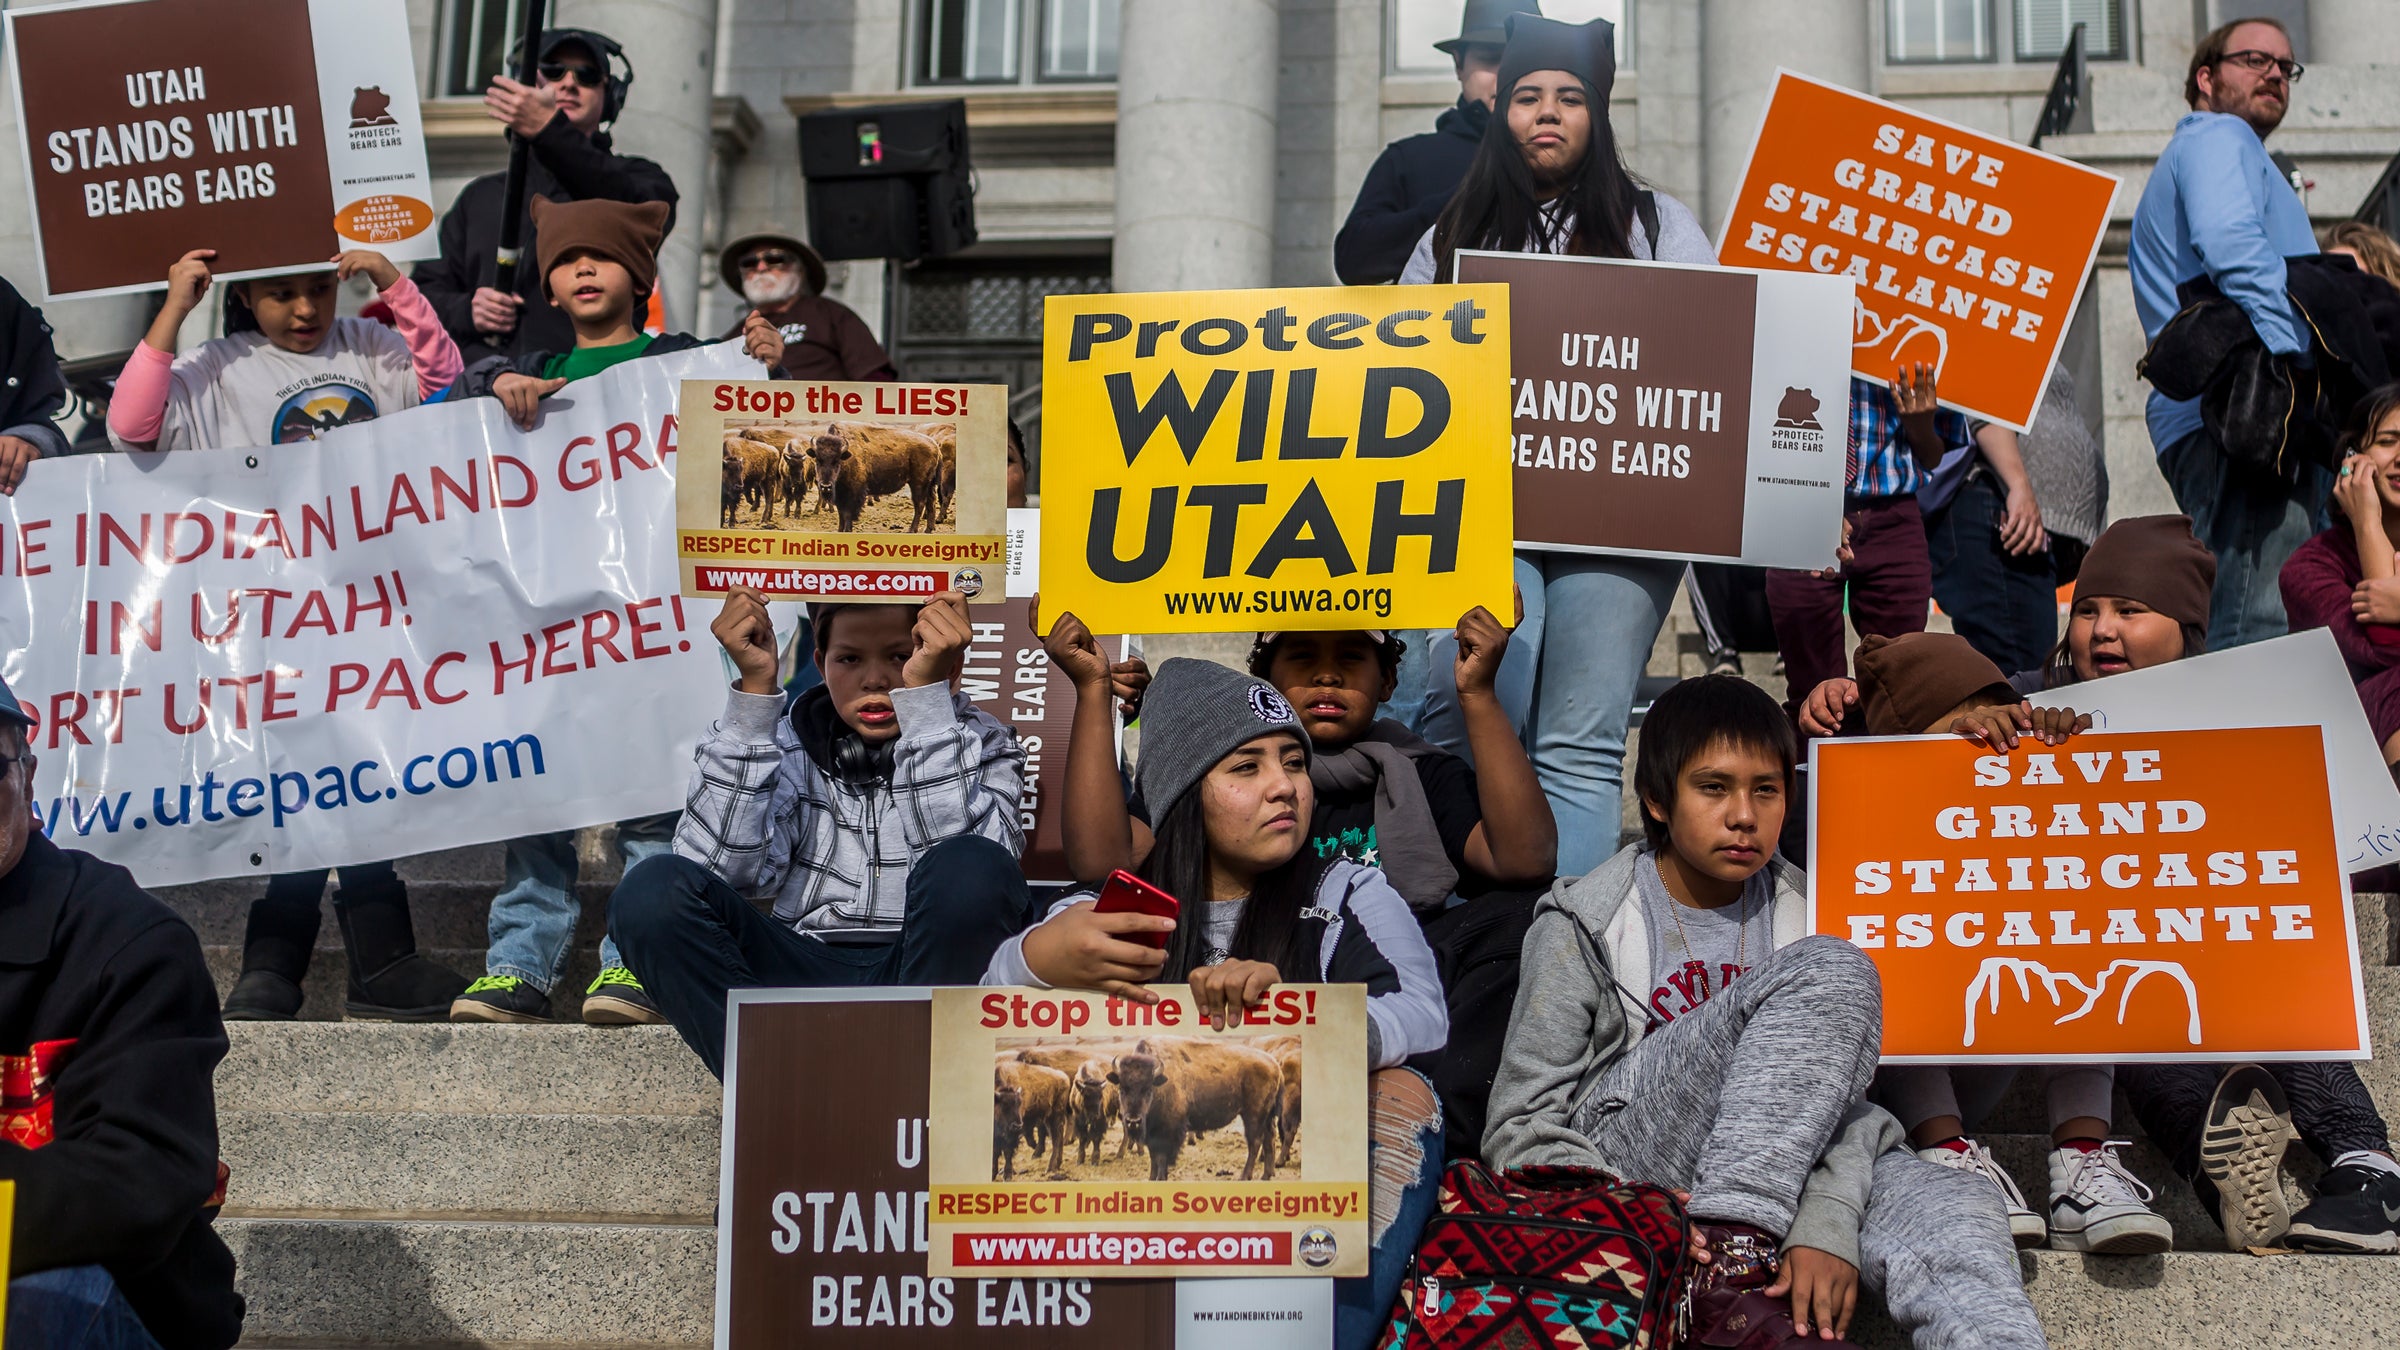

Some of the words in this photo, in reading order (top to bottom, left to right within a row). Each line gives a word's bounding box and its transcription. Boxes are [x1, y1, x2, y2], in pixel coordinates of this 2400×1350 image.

[126, 66, 206, 108] UTAH
[48, 116, 195, 174] STANDS
[207, 104, 298, 154] WITH
[350, 138, 377, 150] BEARS
[380, 137, 402, 149] EARS
[355, 128, 396, 138] PROTECT
[1873, 123, 2004, 188] SAVE
[84, 172, 185, 218] BEARS
[195, 162, 277, 204] EARS
[363, 203, 399, 215] GRAND
[366, 196, 393, 206] SAVE
[1834, 158, 2013, 237] GRAND
[353, 210, 412, 224] STAIRCASE
[1764, 182, 2055, 299] STAIRCASE
[1744, 221, 2044, 342] ESCALANTE
[1068, 298, 1487, 362] Protect
[1561, 332, 1640, 371] UTAH
[275, 385, 294, 399] THE
[294, 378, 311, 391] UTE
[311, 372, 346, 385] INDIAN
[713, 384, 796, 418] Stop
[806, 385, 863, 416] the
[875, 387, 970, 416] LIES!
[1510, 377, 1618, 425] ANDS
[1636, 385, 1722, 433] WITH
[1103, 366, 1452, 469] WILD
[1777, 429, 1820, 442] PROTECT
[1611, 439, 1691, 479] EARS
[1772, 440, 1799, 451] BEARS
[1802, 443, 1824, 453] EARS
[76, 495, 337, 567] INDIAN
[350, 454, 539, 542] LAND
[557, 413, 681, 492] GRA
[683, 535, 776, 555] RESPECT
[782, 538, 849, 557] Indian
[856, 540, 999, 562] Sovereignty!
[1014, 529, 1025, 549] EARS
[1086, 476, 1466, 584] UTAH
[706, 569, 934, 594] www.utepac.com
[1012, 551, 1023, 576] BEARS
[84, 599, 162, 655] IN
[190, 569, 413, 646] UTAH!
[1164, 587, 1392, 618] www.suwa.org
[163, 669, 303, 735] UTE
[325, 651, 469, 713] PAC
[488, 594, 691, 696] HERE!
[960, 623, 1005, 702] WITH
[1011, 648, 1049, 721] EARS
[1973, 749, 2162, 788] SAVE
[1934, 800, 2207, 841] GRAND
[1854, 849, 2300, 895] STAIRCASE
[1846, 904, 2314, 950] ESCALANTE
[980, 993, 1090, 1034] Stop
[1105, 994, 1182, 1026] the
[771, 1191, 929, 1254] STAND
[938, 1192, 1067, 1215] RESPECT
[1076, 1191, 1163, 1214] Indian
[1172, 1191, 1359, 1218] Sovereignty!
[970, 1233, 1273, 1264] www.utepac.com
[811, 1275, 954, 1327] BEARS
[977, 1277, 1091, 1327] EARS
[1193, 1311, 1303, 1322] WWW.UTAHDINEBIKEYAH.ORG
